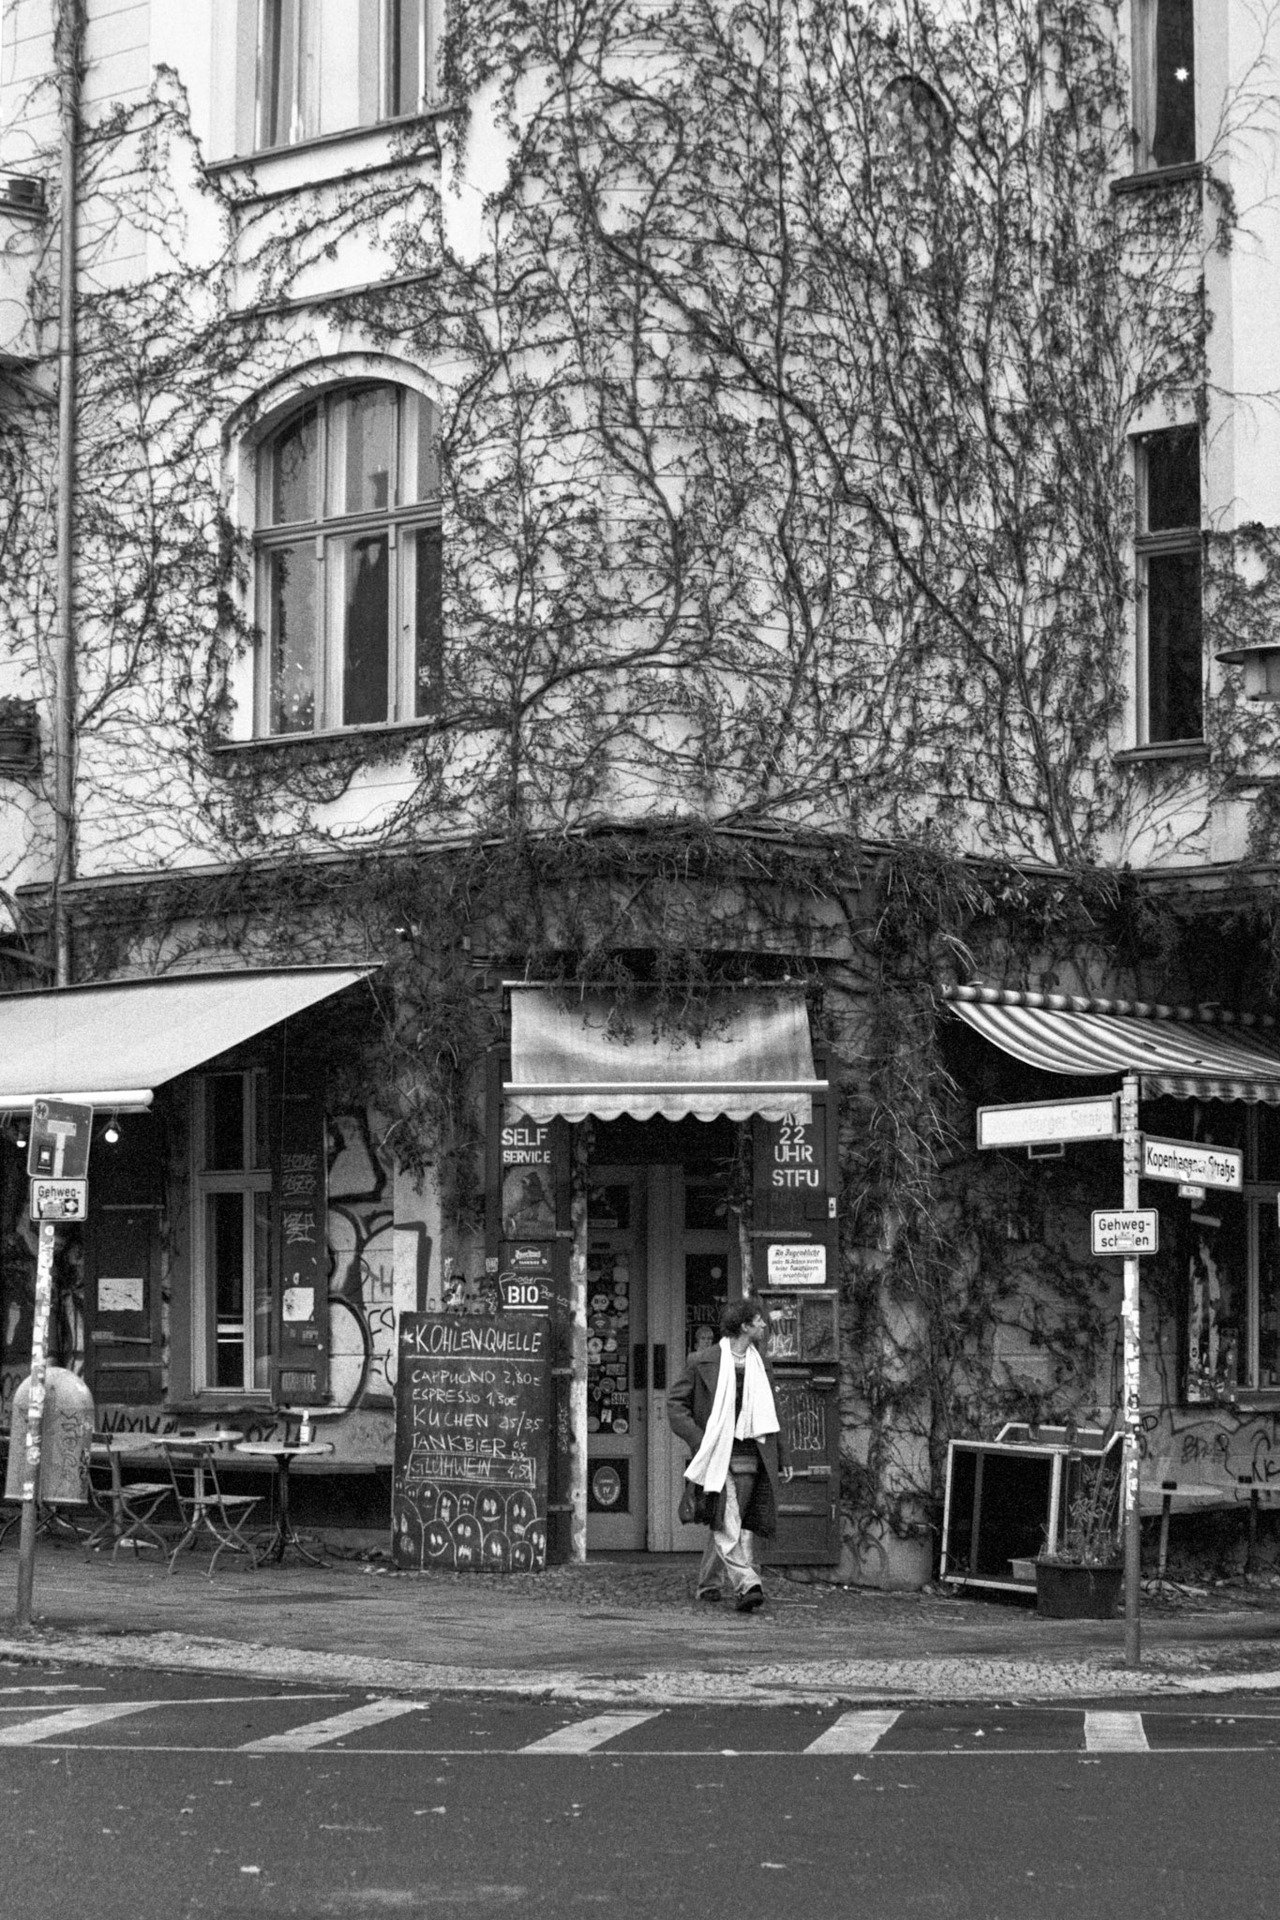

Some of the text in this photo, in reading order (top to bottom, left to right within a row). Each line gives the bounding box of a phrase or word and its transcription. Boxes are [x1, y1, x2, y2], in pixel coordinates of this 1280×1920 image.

[501, 1128, 548, 1146] SELF
[779, 1126, 805, 1144] 22
[503, 1150, 551, 1163] SERVICE
[774, 1145, 813, 1163] UHR
[772, 1169, 819, 1187] STFU
[1099, 1218, 1151, 1233] Gehweg-
[507, 1285, 539, 1304] BIO
[416, 1324, 542, 1353] KOHLENQUELLE
[412, 1388, 481, 1404] ESPRESSO
[413, 1405, 488, 1428] KUCHEN
[411, 1432, 506, 1458] TANKBIER
